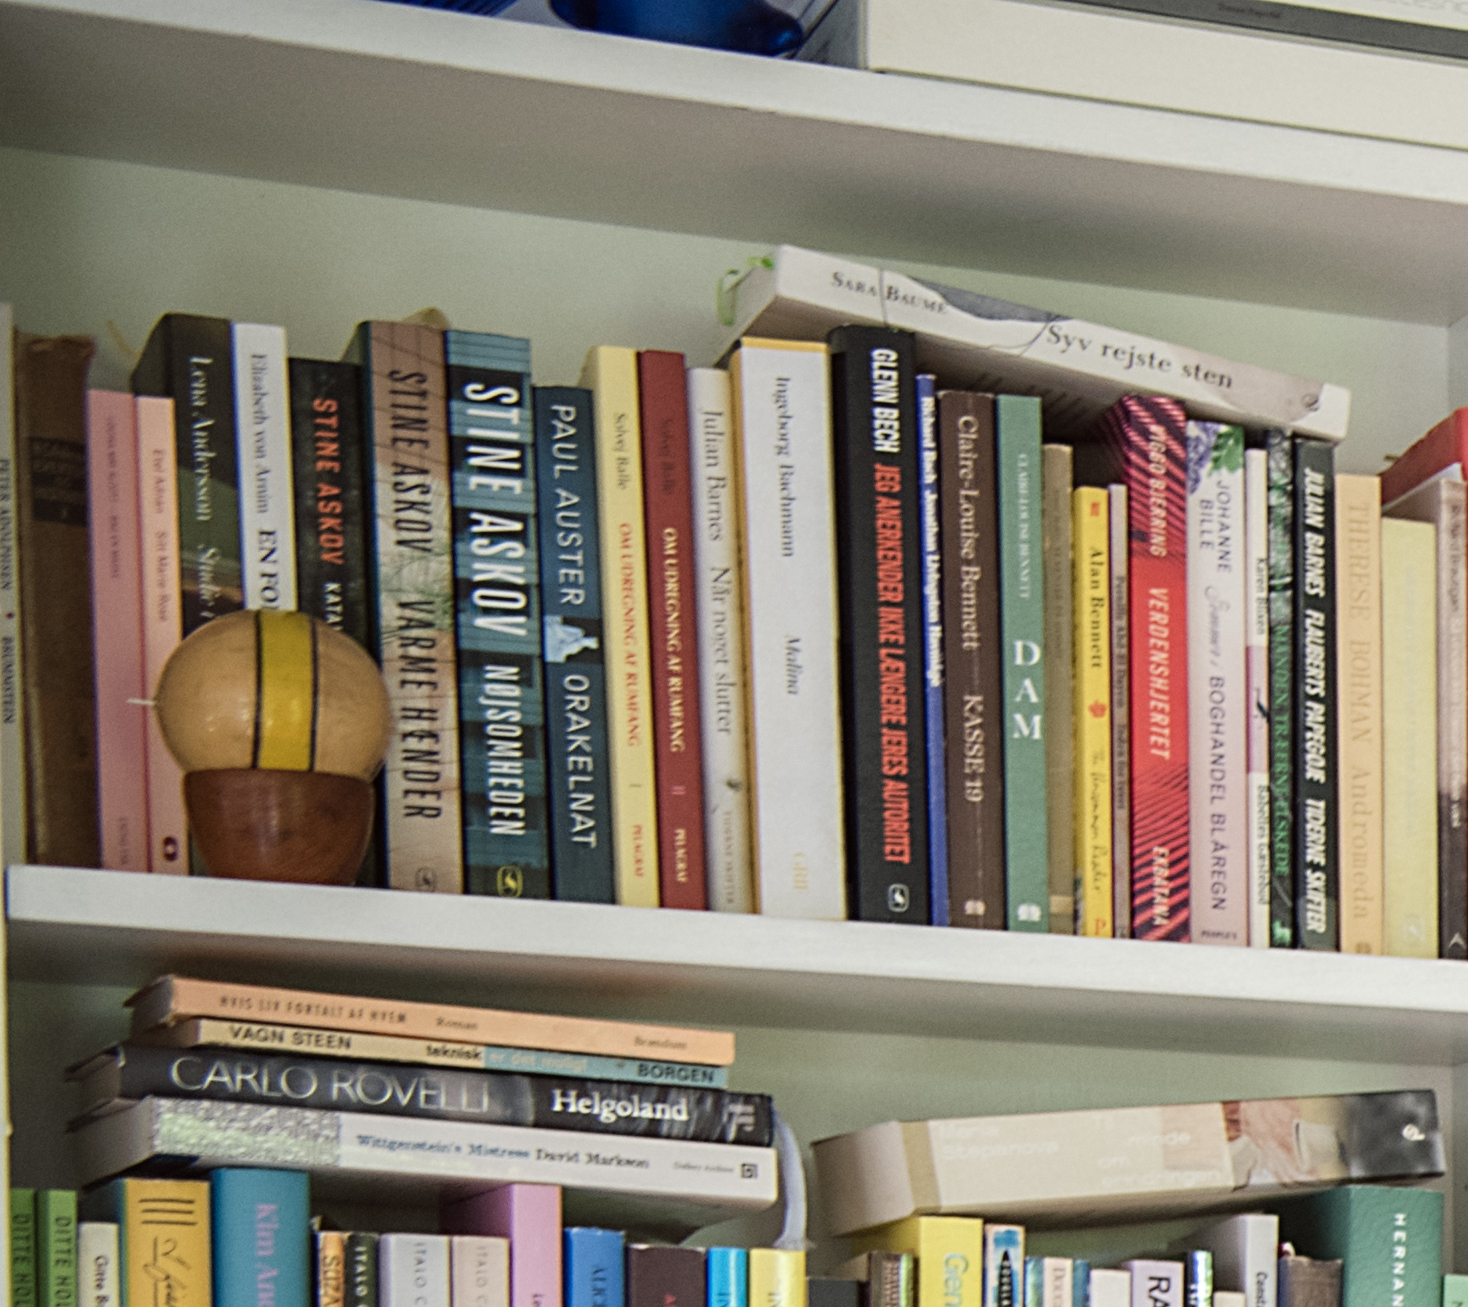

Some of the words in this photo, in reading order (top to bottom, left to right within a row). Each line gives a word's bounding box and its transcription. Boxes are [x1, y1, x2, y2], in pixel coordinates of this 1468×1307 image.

[872, 348, 897, 400] GLENN
[1045, 324, 1092, 356] Syv
[1100, 339, 1172, 375] rejste
[1181, 355, 1234, 388] sten
[313, 398, 340, 473] STINE
[466, 384, 520, 495] STINE
[550, 405, 576, 479] PAUL
[875, 405, 899, 453] BECH
[317, 484, 343, 565] ASKOV
[556, 489, 582, 606] AUSTER
[470, 512, 527, 637] ASKOV
[1148, 587, 1169, 760] VERDENSHJERTET
[564, 675, 595, 849] ORAKELNAT
[229, 1025, 285, 1045] VAGN
[292, 1031, 352, 1051] STEEN
[637, 1061, 715, 1083] BORGEN
[171, 1057, 317, 1099] CARLO
[332, 1072, 489, 1113] ROVELLI
[551, 1088, 690, 1123] Helgoland
